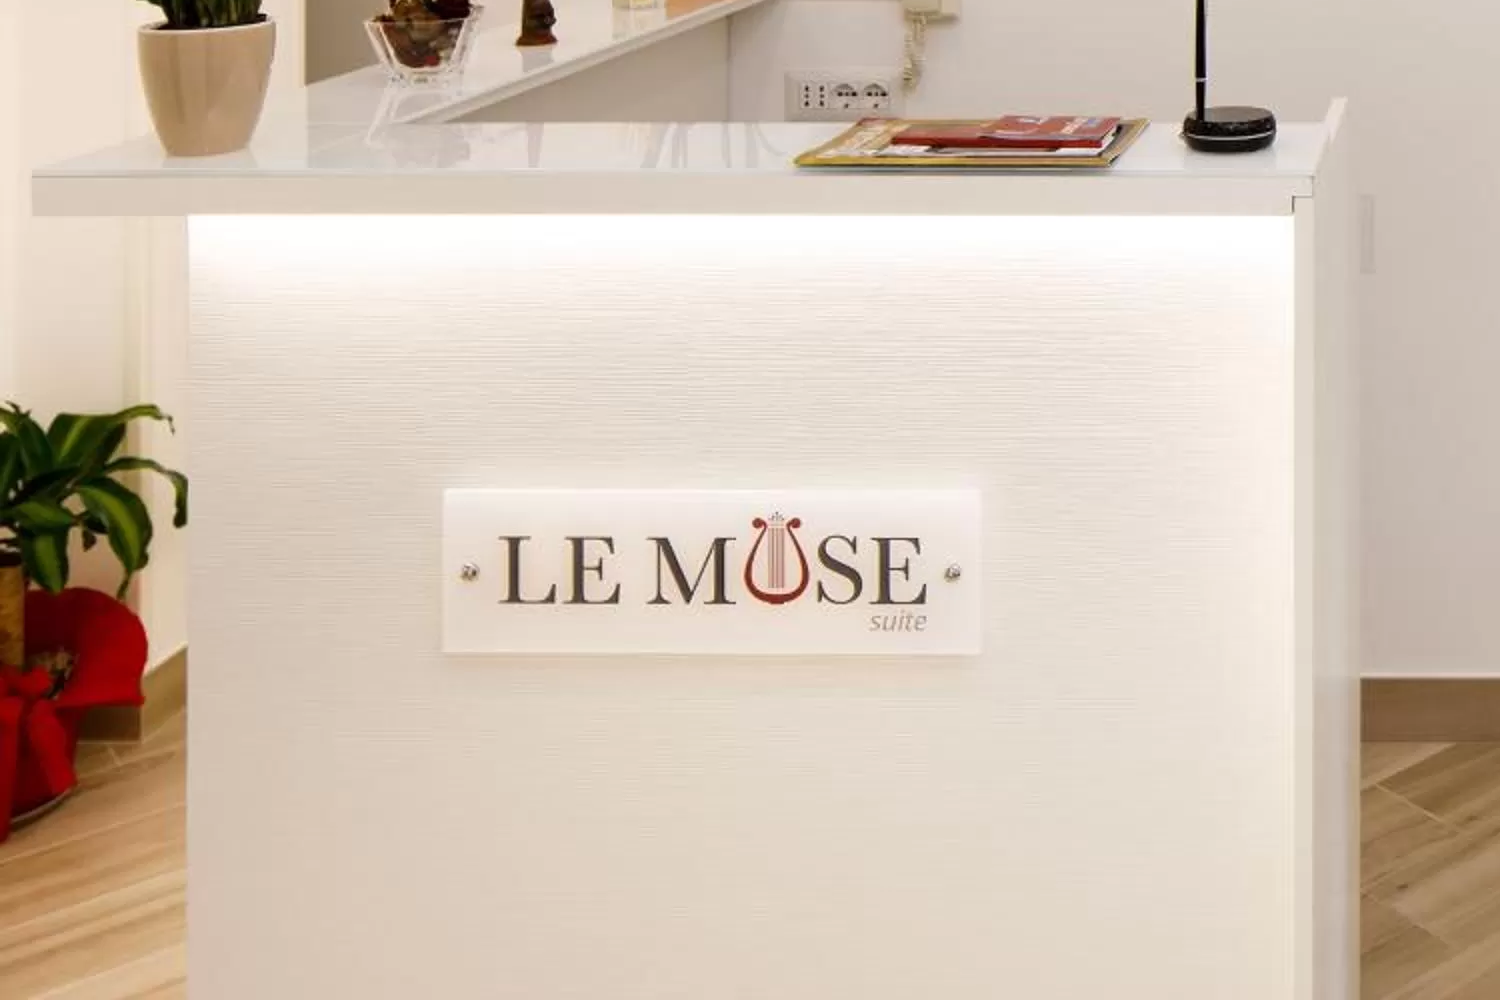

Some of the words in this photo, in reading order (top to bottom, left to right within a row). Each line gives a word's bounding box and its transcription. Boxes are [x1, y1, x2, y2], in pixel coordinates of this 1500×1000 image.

[498, 535, 621, 605] LE
[646, 511, 928, 606] MUSE
[869, 610, 928, 633] suite
